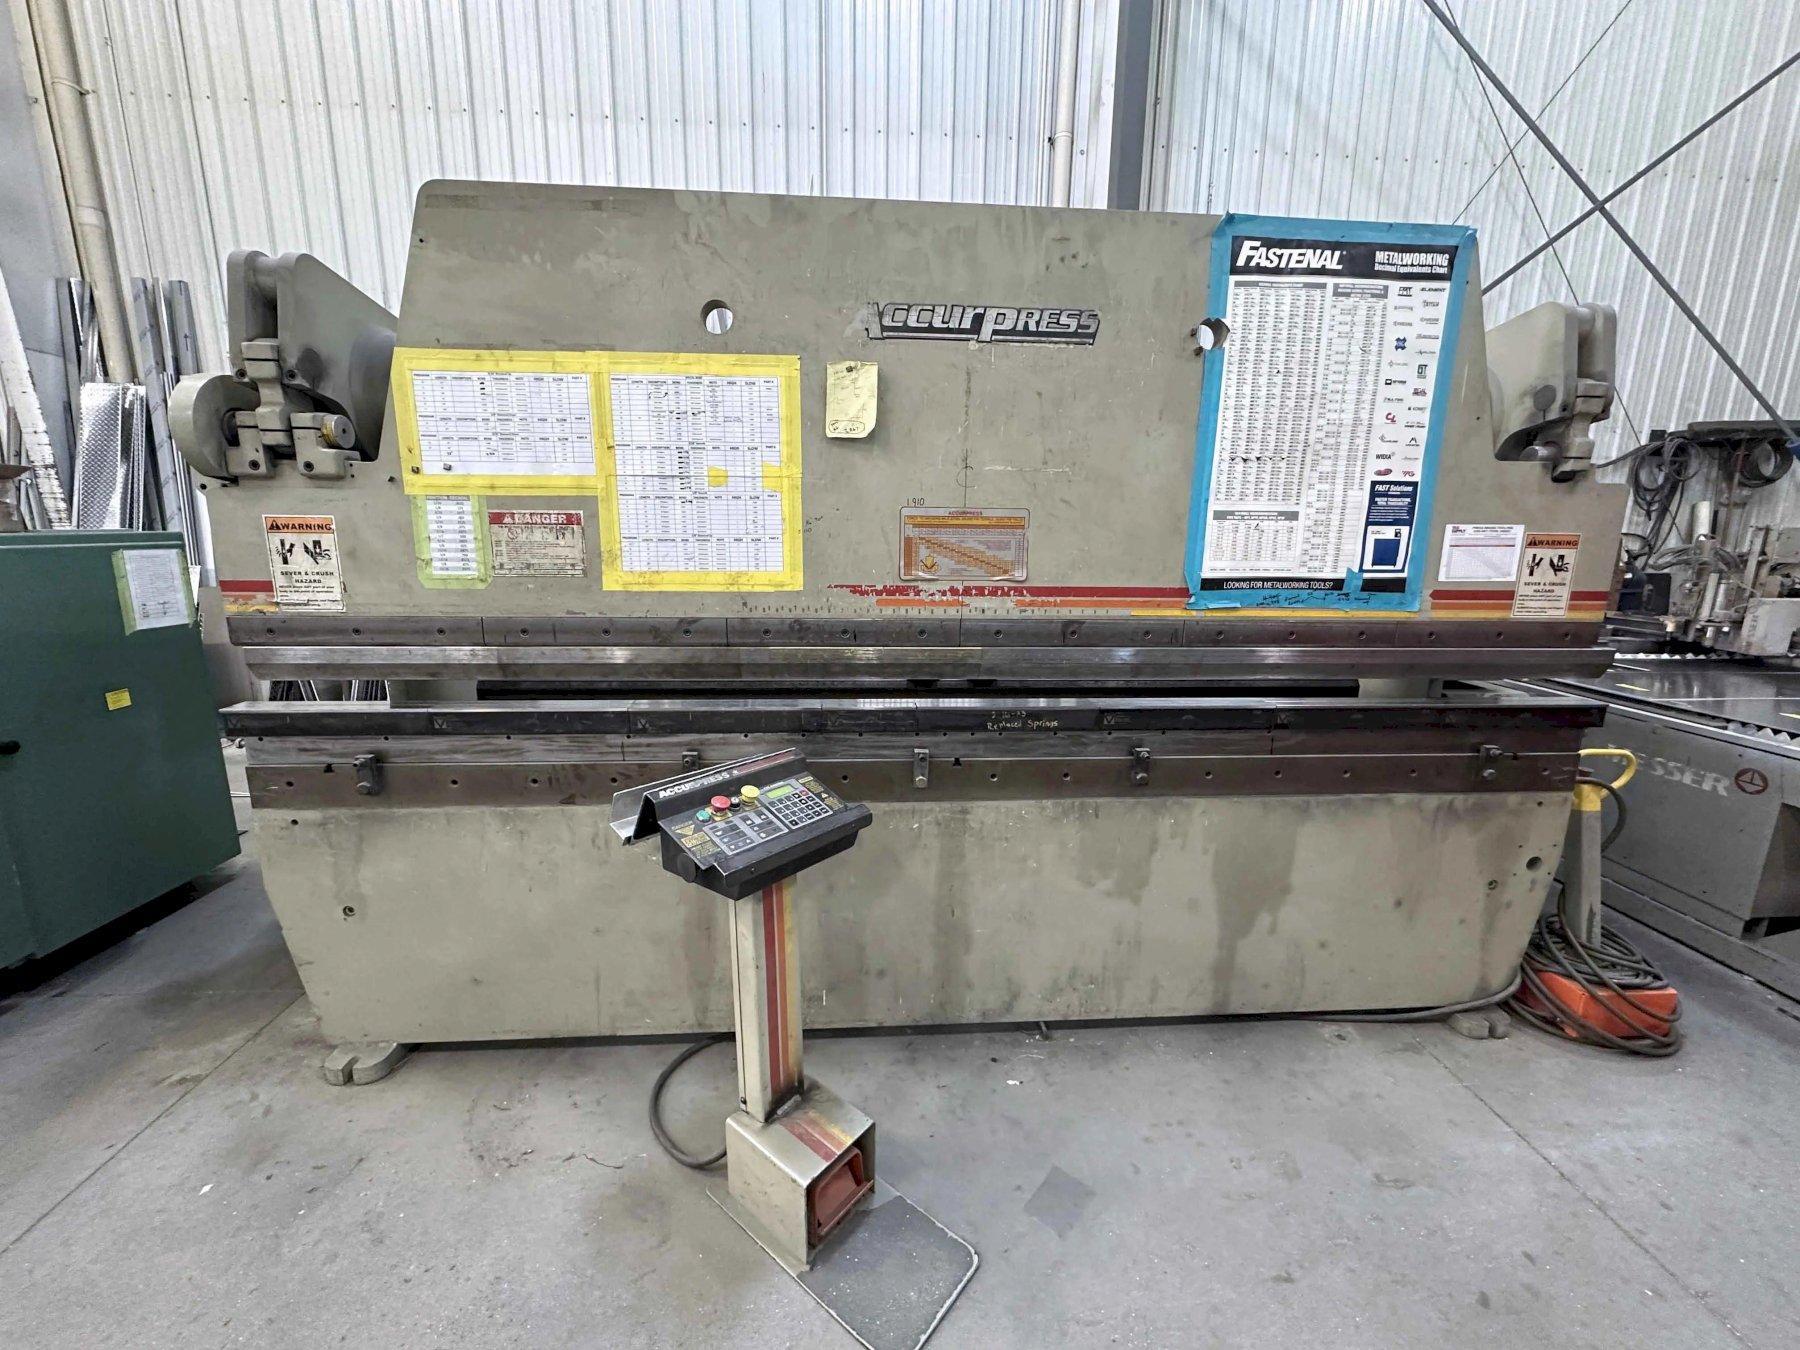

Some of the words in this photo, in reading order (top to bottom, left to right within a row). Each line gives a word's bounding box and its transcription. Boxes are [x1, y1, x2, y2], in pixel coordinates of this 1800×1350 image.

[1235, 240, 1343, 270] FASTENAL
[1374, 250, 1450, 266] METALWORKING
[1432, 266, 1448, 274] Chart
[1028, 720, 1058, 730] Springs
